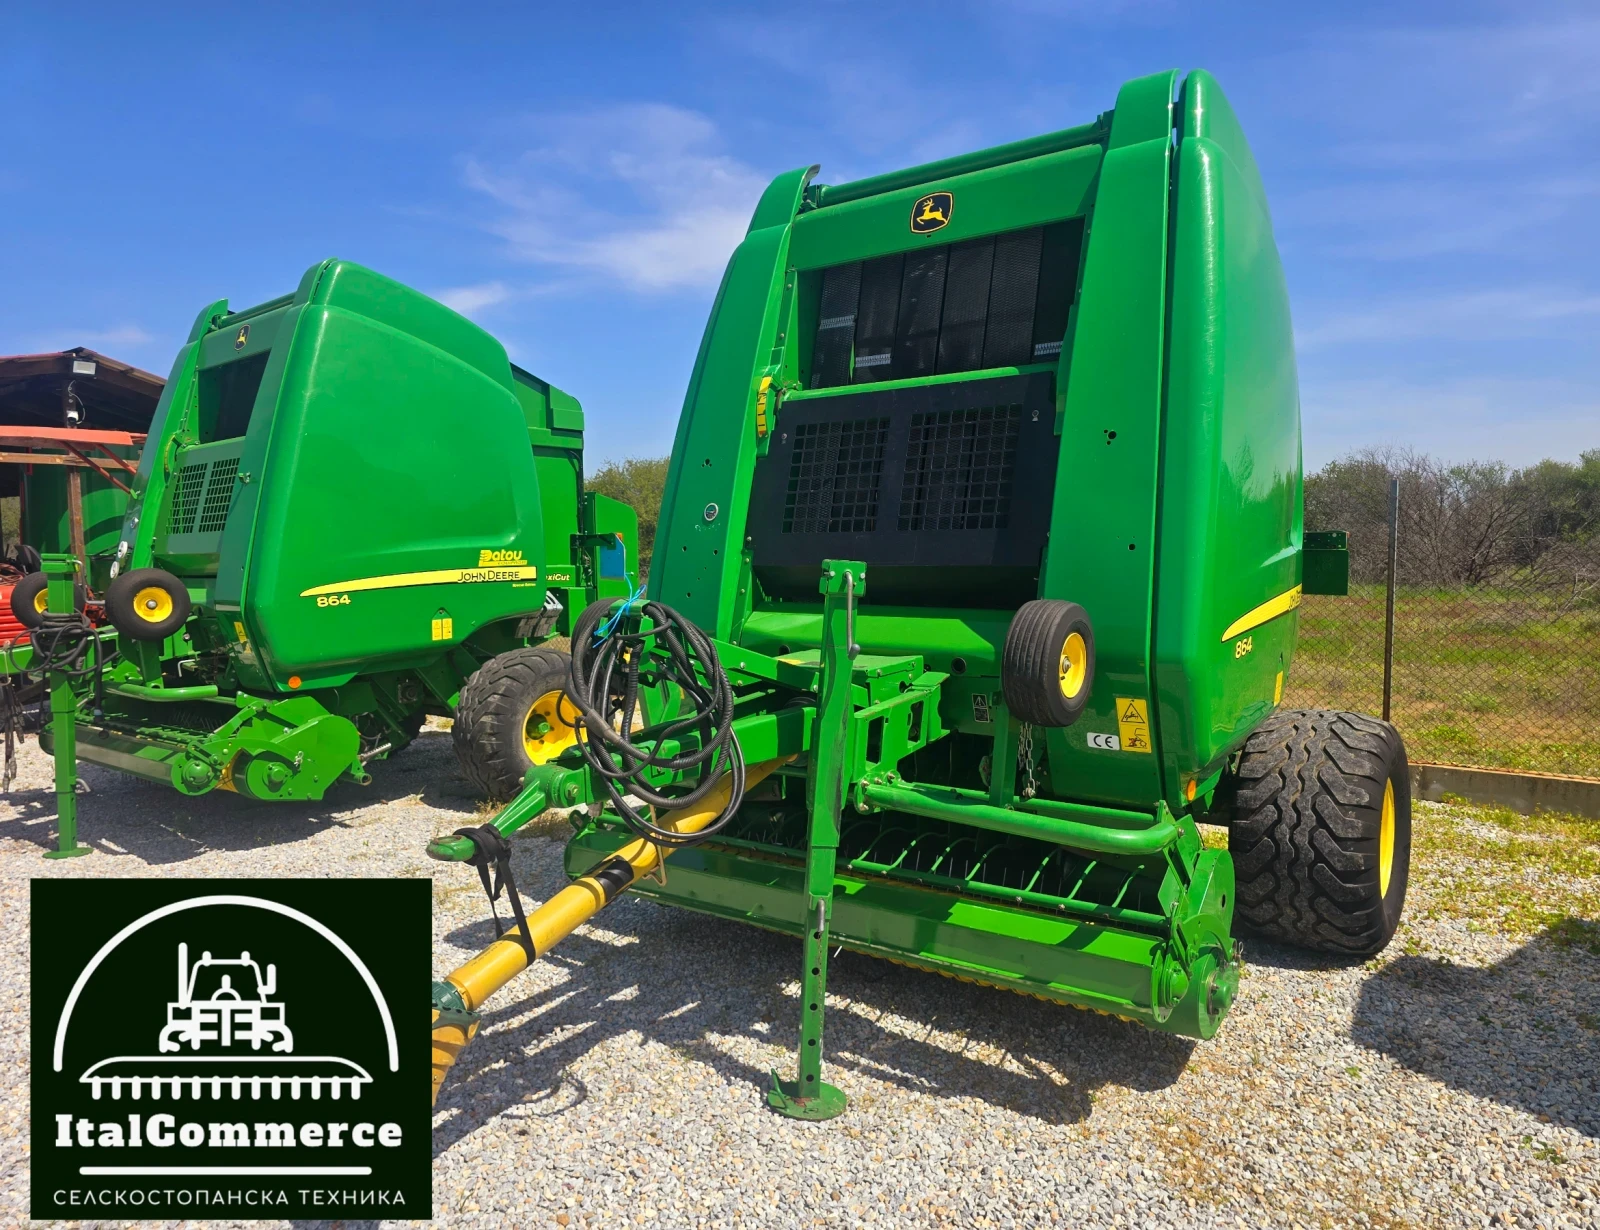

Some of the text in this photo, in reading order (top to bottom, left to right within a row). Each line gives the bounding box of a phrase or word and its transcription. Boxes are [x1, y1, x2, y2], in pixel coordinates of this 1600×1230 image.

[457, 570, 520, 582] JOHN DEERE
[316, 594, 351, 608] 864
[1235, 635, 1253, 659] 864
[1093, 734, 1114, 749] CE
